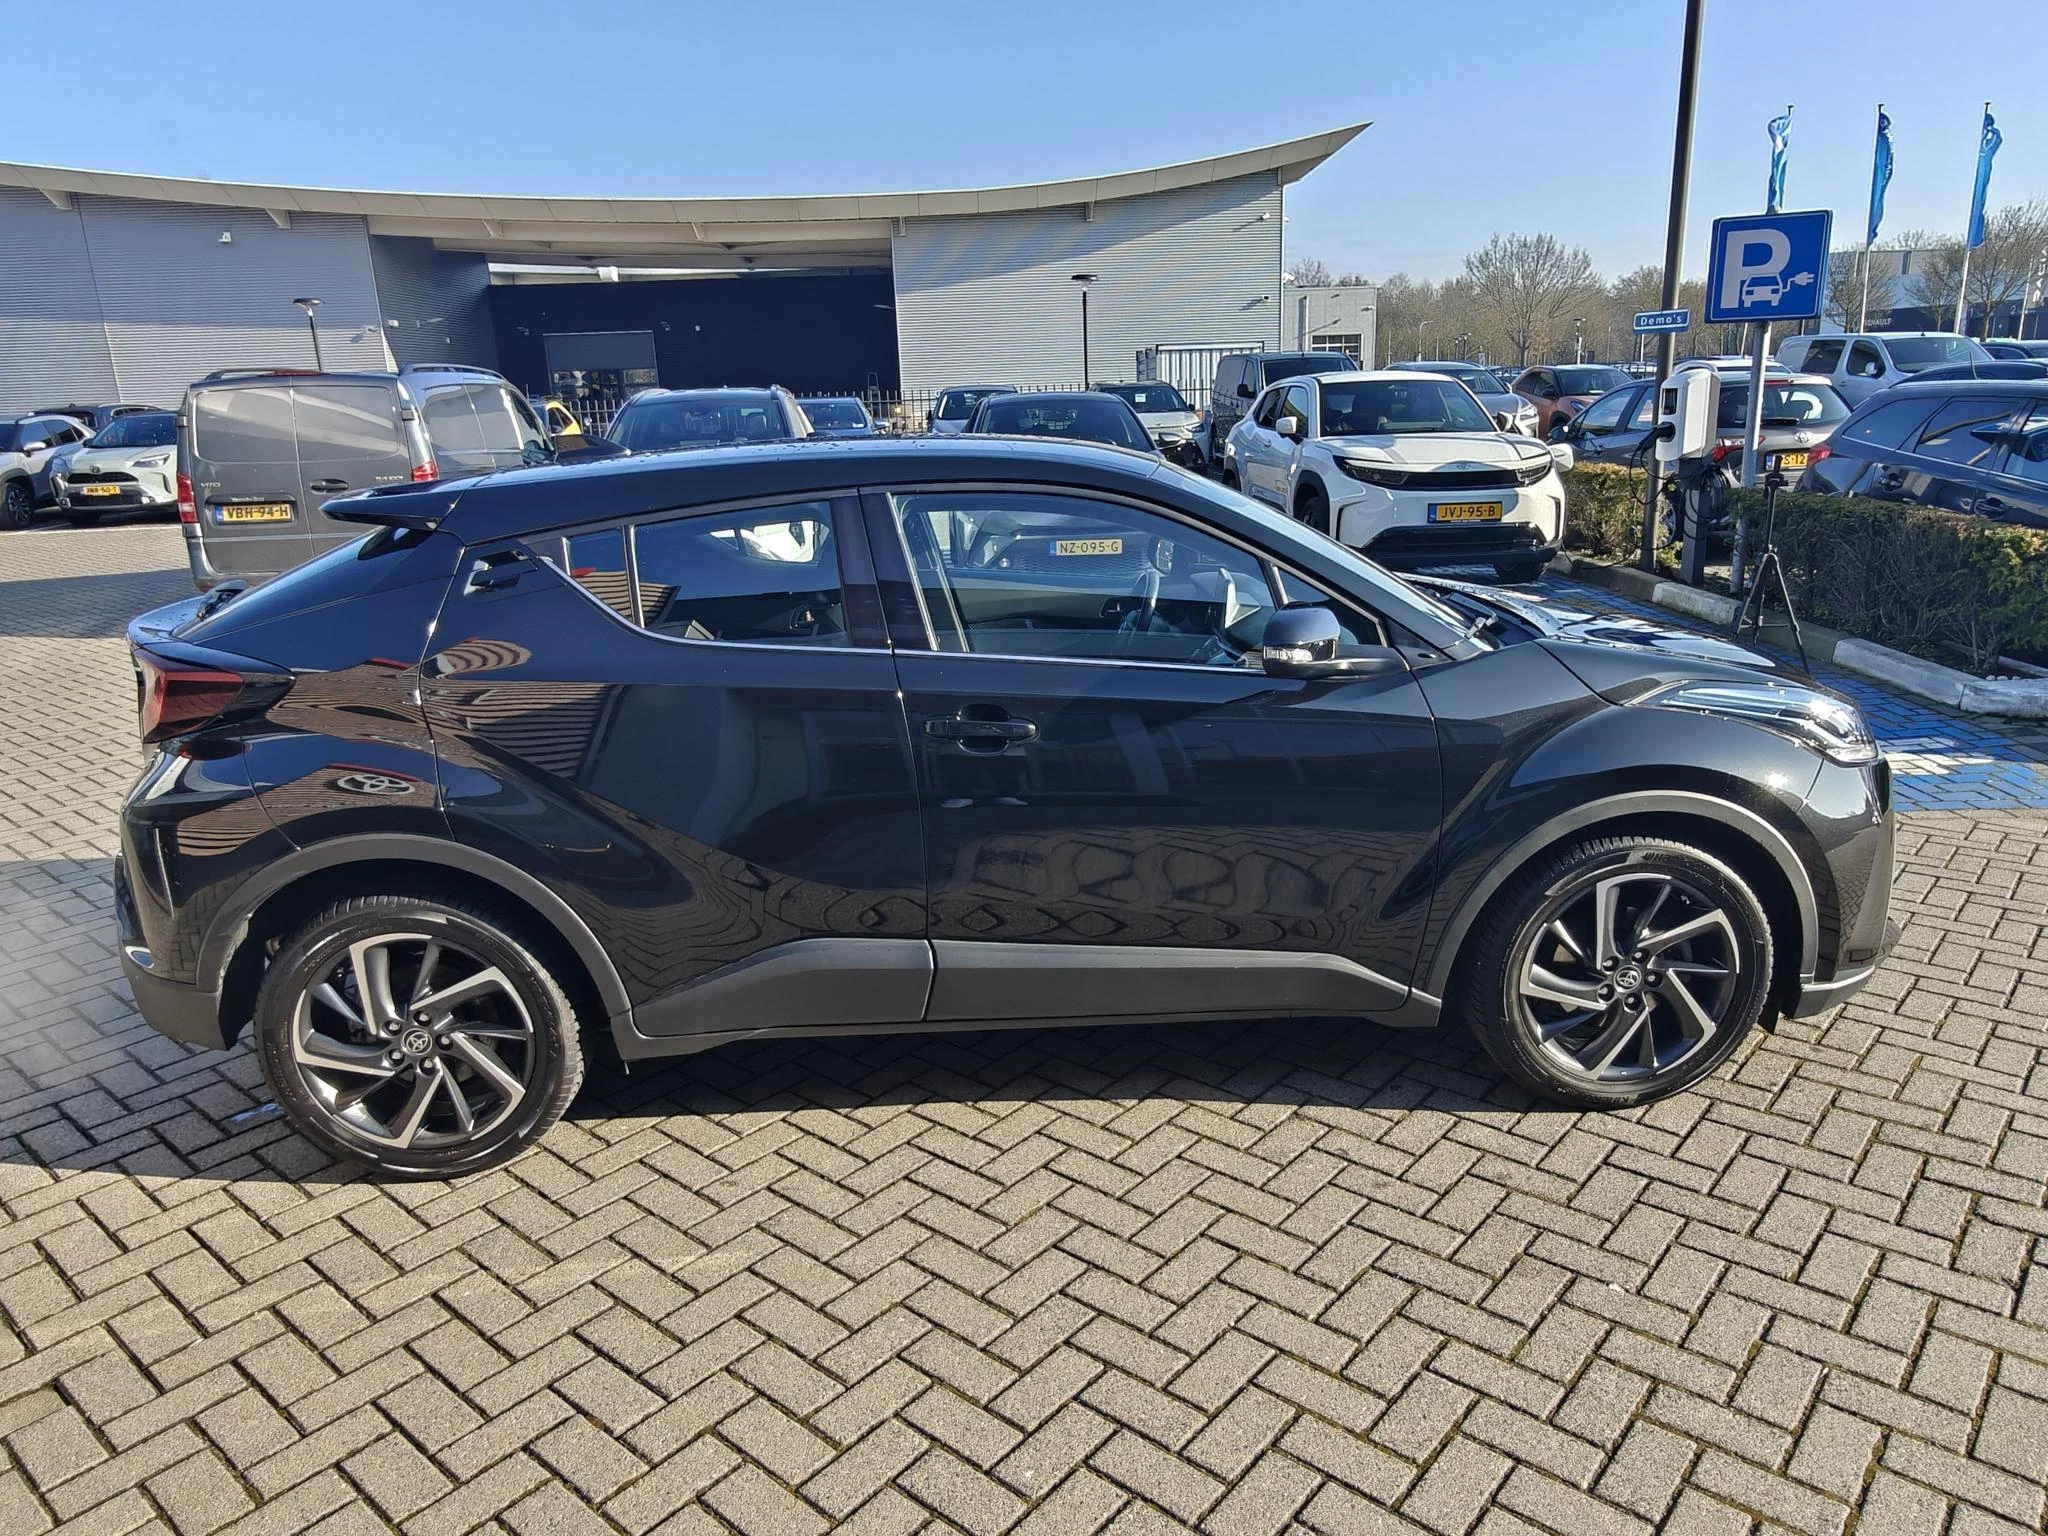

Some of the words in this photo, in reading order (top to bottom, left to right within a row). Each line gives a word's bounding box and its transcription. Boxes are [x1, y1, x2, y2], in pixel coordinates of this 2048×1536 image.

[1720, 229, 1791, 309] P
[1640, 314, 1682, 326] Demo's
[226, 505, 289, 519] VBH-94-H
[1441, 505, 1496, 518] JVJ-95-B
[1059, 541, 1119, 554] NZ-095-G
